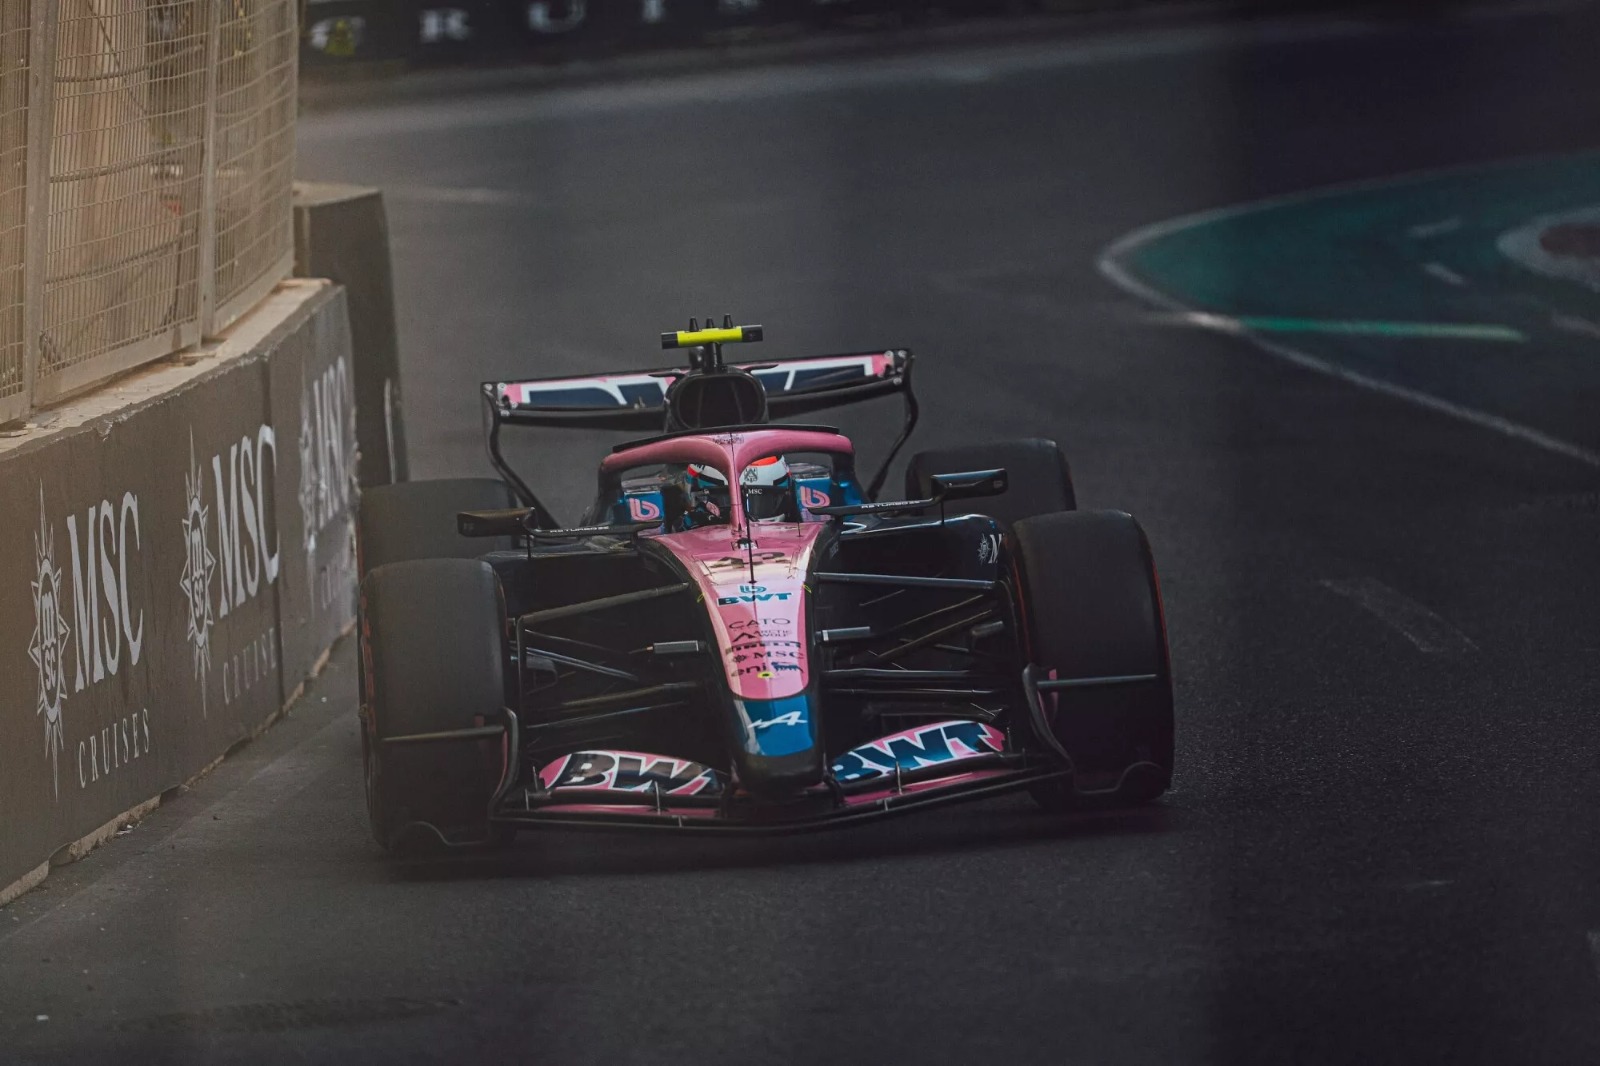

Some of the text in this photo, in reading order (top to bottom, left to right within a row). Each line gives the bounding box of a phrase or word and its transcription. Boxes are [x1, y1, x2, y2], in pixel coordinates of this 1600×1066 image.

[212, 424, 280, 619] MSC
[67, 491, 143, 693] MSC
[718, 592, 792, 605] BWT
[729, 618, 790, 629] CATO
[753, 651, 804, 659] MSC
[79, 708, 149, 788] CRUISES
[831, 721, 1000, 782] BWT
